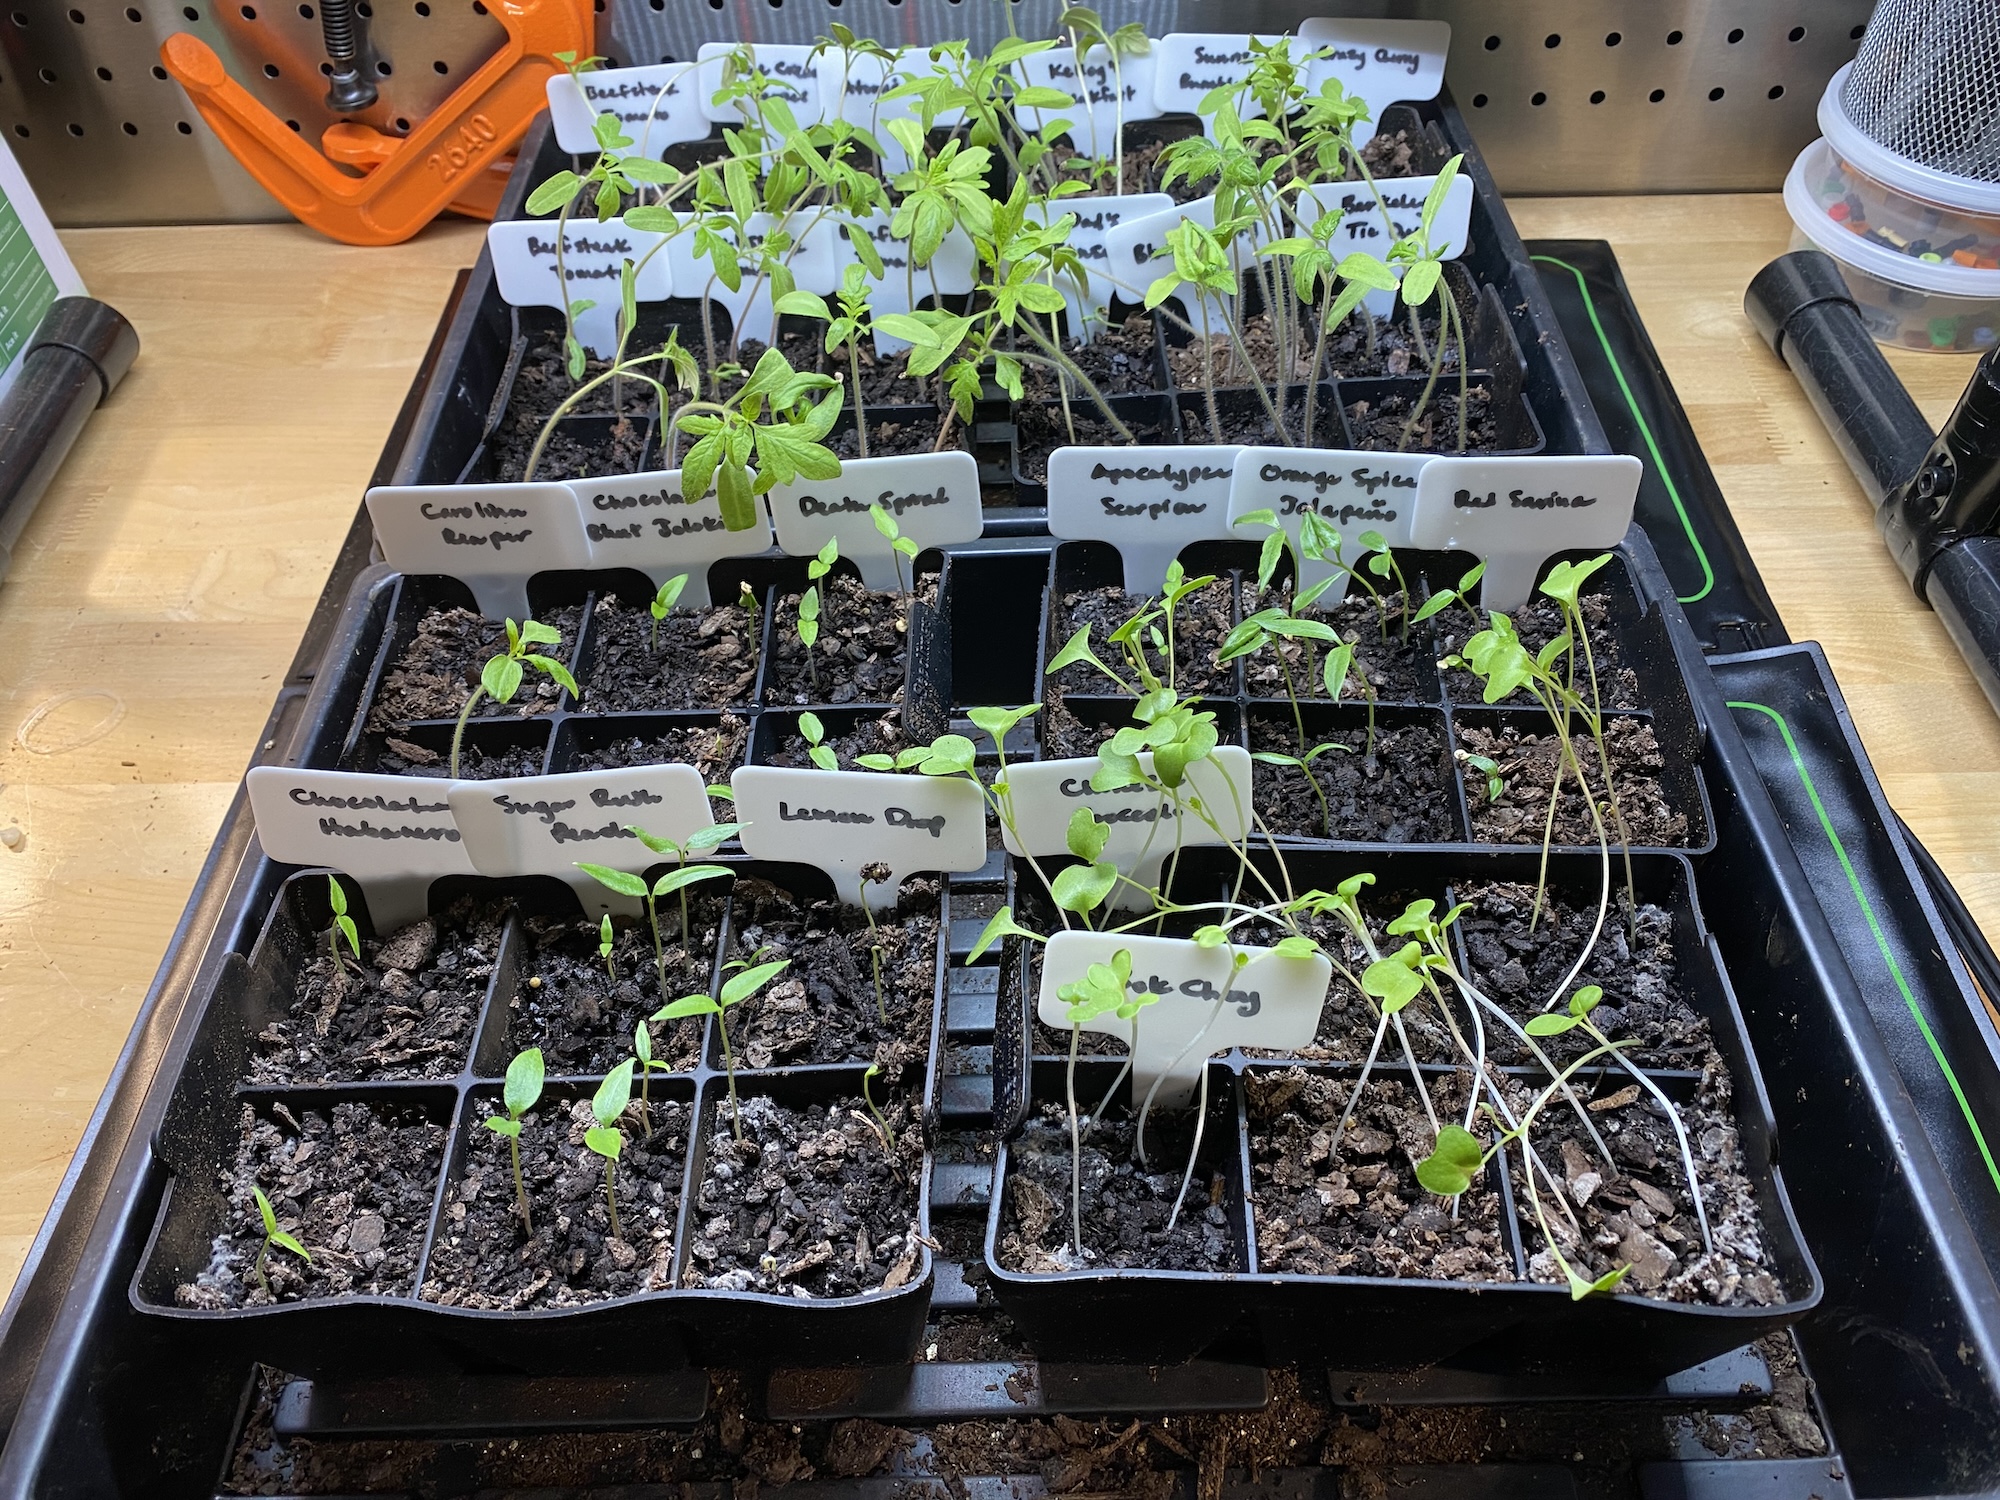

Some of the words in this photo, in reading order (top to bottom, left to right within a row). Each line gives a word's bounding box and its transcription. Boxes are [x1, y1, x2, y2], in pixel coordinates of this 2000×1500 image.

[427, 114, 497, 183] 2640
[1345, 221, 1379, 240] Tie
[549, 264, 622, 281] Tomat
[1259, 463, 1343, 494] Orange
[1351, 468, 1418, 496] Spice
[420, 502, 528, 520] Carolina
[592, 489, 717, 511] Chocolae
[1453, 489, 1497, 509] Red
[1508, 489, 1598, 510] Savina
[441, 528, 533, 551] Reaper
[493, 794, 576, 824] Sugar
[779, 801, 875, 824] Lemon
[884, 807, 946, 838] Drop
[318, 817, 461, 843] Habanero
[1126, 974, 1174, 995] ok
[1179, 979, 1261, 1018] Choy
